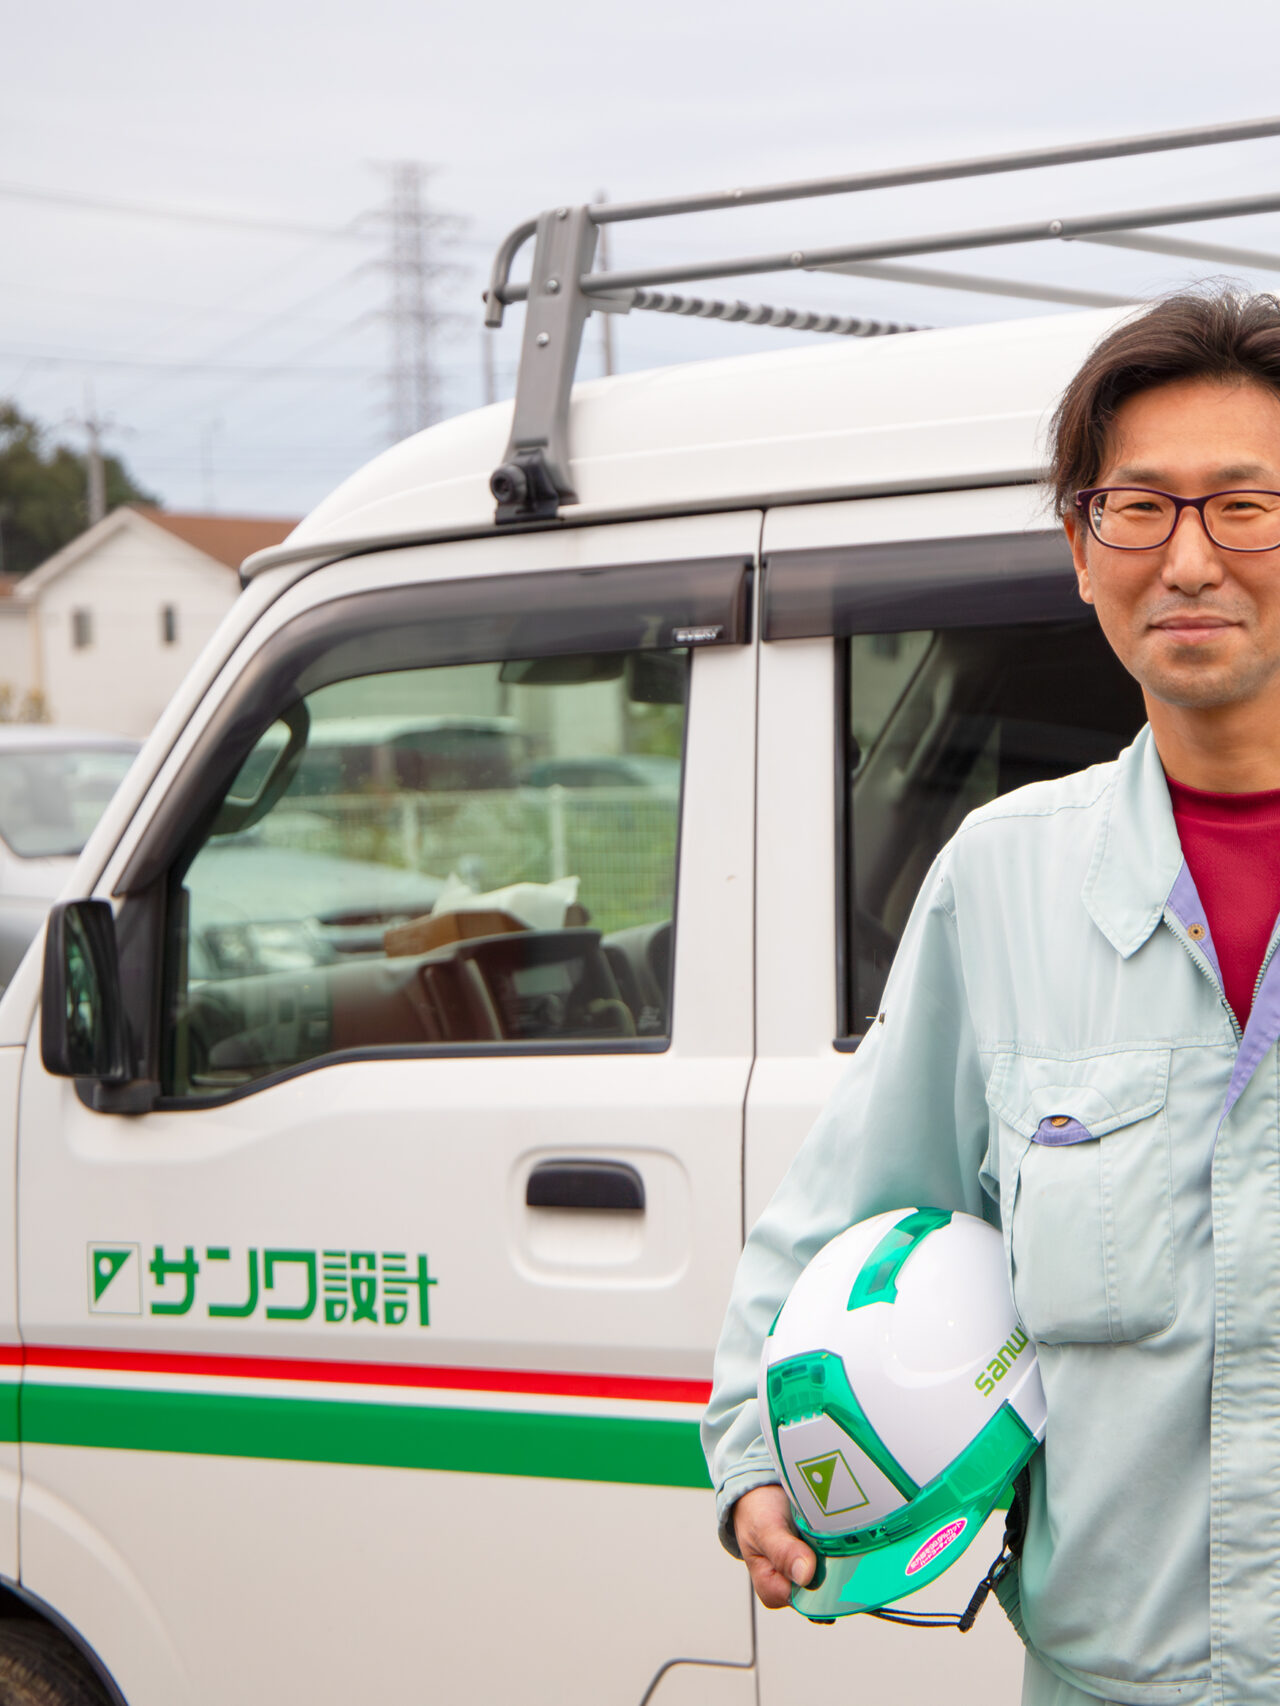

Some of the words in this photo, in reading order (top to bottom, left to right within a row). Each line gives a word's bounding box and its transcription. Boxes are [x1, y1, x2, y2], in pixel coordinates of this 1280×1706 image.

[149, 1244, 438, 1327] サンワ設計
[974, 1323, 1030, 1397] sanw
